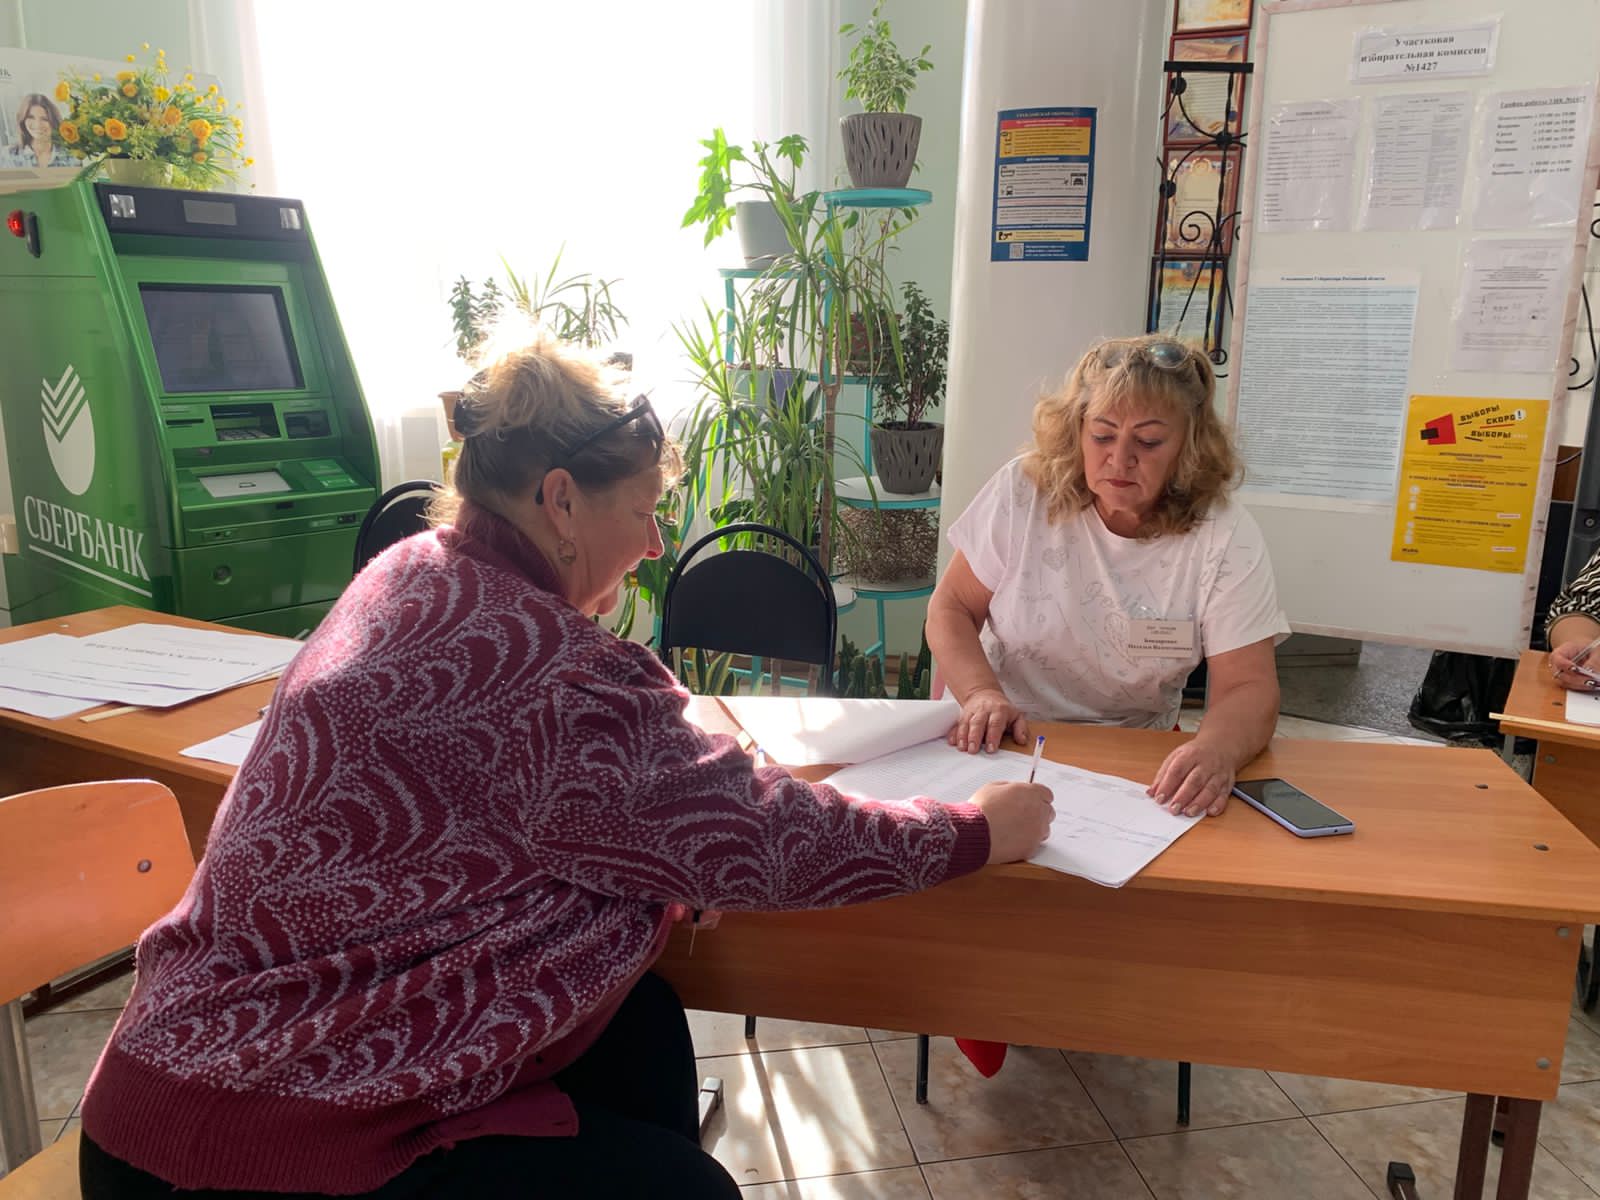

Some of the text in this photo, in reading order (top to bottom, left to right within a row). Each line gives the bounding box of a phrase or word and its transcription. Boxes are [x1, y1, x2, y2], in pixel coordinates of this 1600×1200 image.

[1394, 35, 1455, 47] Участковая
[1360, 47, 1487, 63] избирательная комиссия
[1404, 62, 1438, 73] №1427
[1459, 404, 1501, 422] ВЫБОРЫ
[1470, 430, 1511, 439] ВЫБОРЫ
[23, 494, 151, 582] СБЕРБАНК
